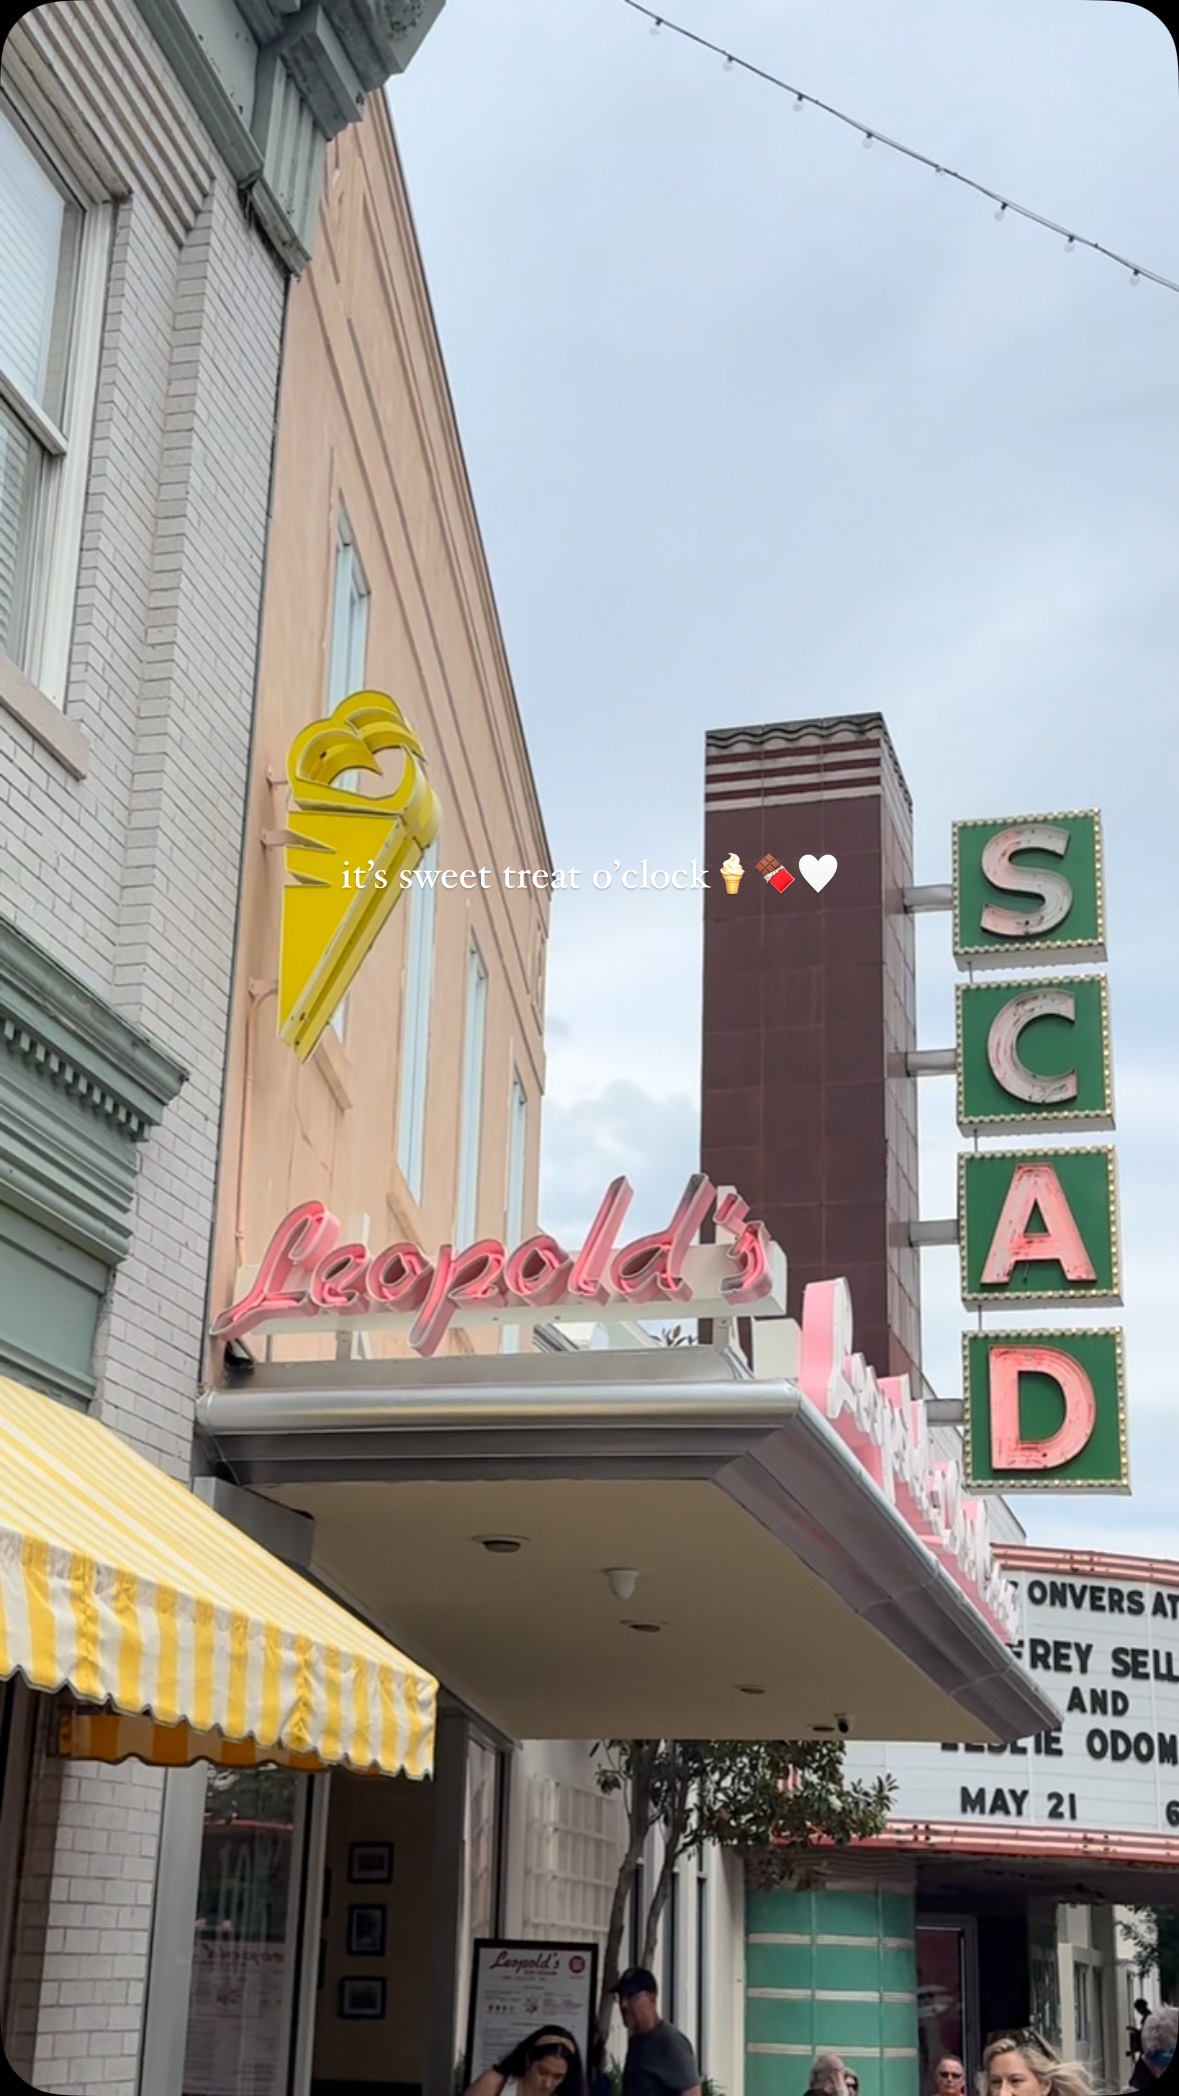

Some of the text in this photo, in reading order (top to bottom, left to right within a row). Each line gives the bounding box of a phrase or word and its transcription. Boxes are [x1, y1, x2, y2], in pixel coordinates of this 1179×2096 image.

[980, 823, 1096, 1471] SCAD
[210, 1173, 774, 1358] Leopold's
[1066, 1685, 1130, 1717] AND
[1086, 1728, 1178, 1766] ODOM
[960, 1786, 1029, 1817] MAY
[1047, 1792, 1077, 1821] 21
[489, 1950, 560, 1974] Leopold's
